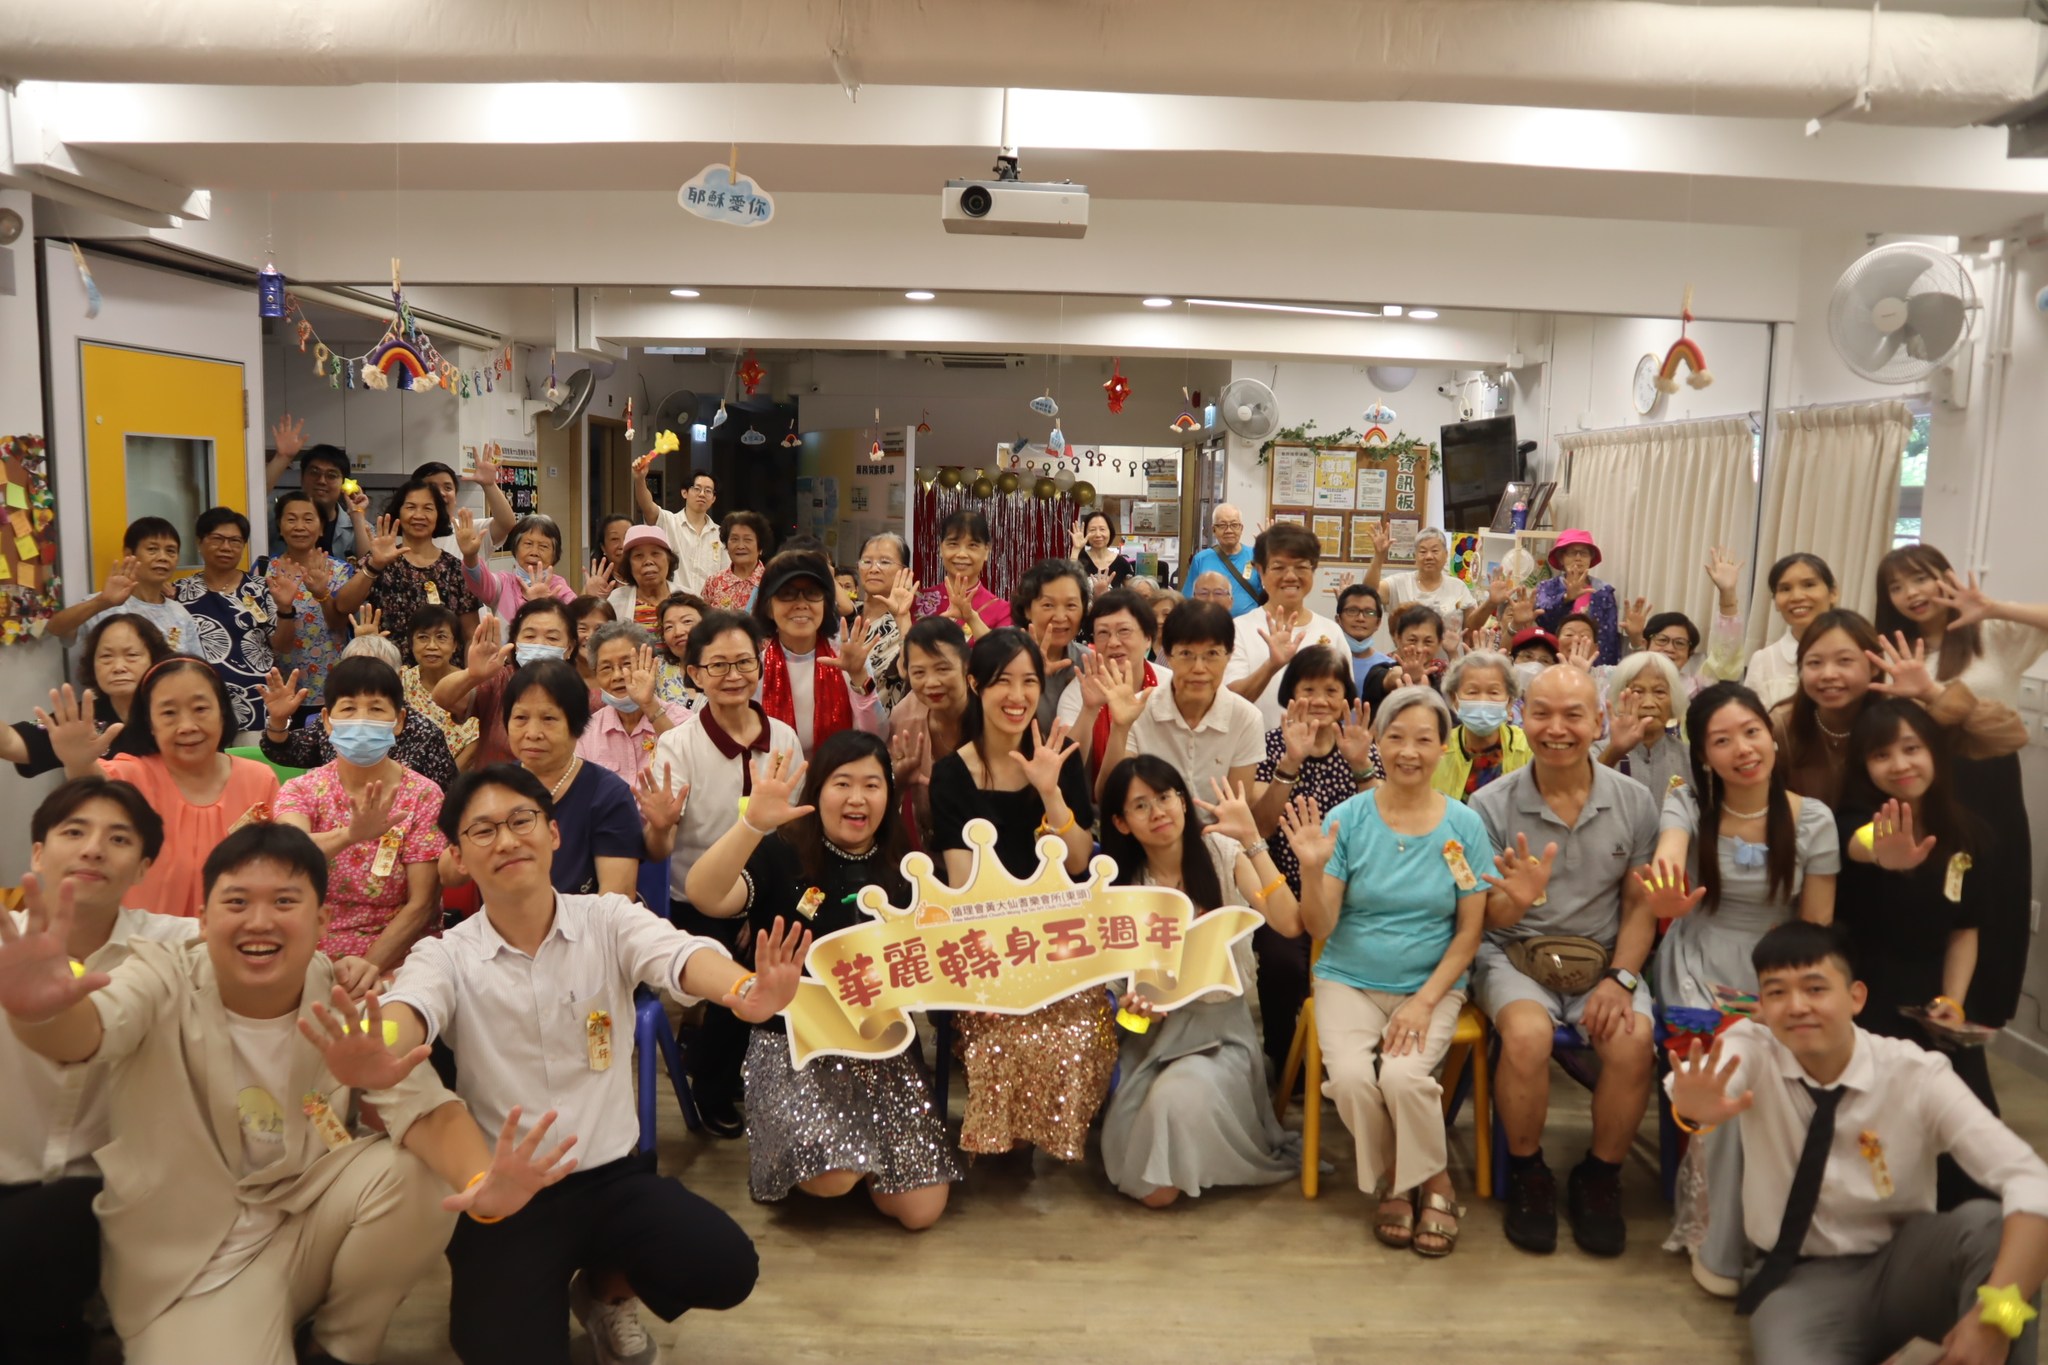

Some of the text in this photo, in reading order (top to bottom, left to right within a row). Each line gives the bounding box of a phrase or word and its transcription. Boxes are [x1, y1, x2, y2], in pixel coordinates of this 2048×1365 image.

[687, 186, 767, 217] 耶穌愛你
[1397, 454, 1416, 511] 資訊板
[831, 912, 1182, 1009] 華麗轉身五週年
